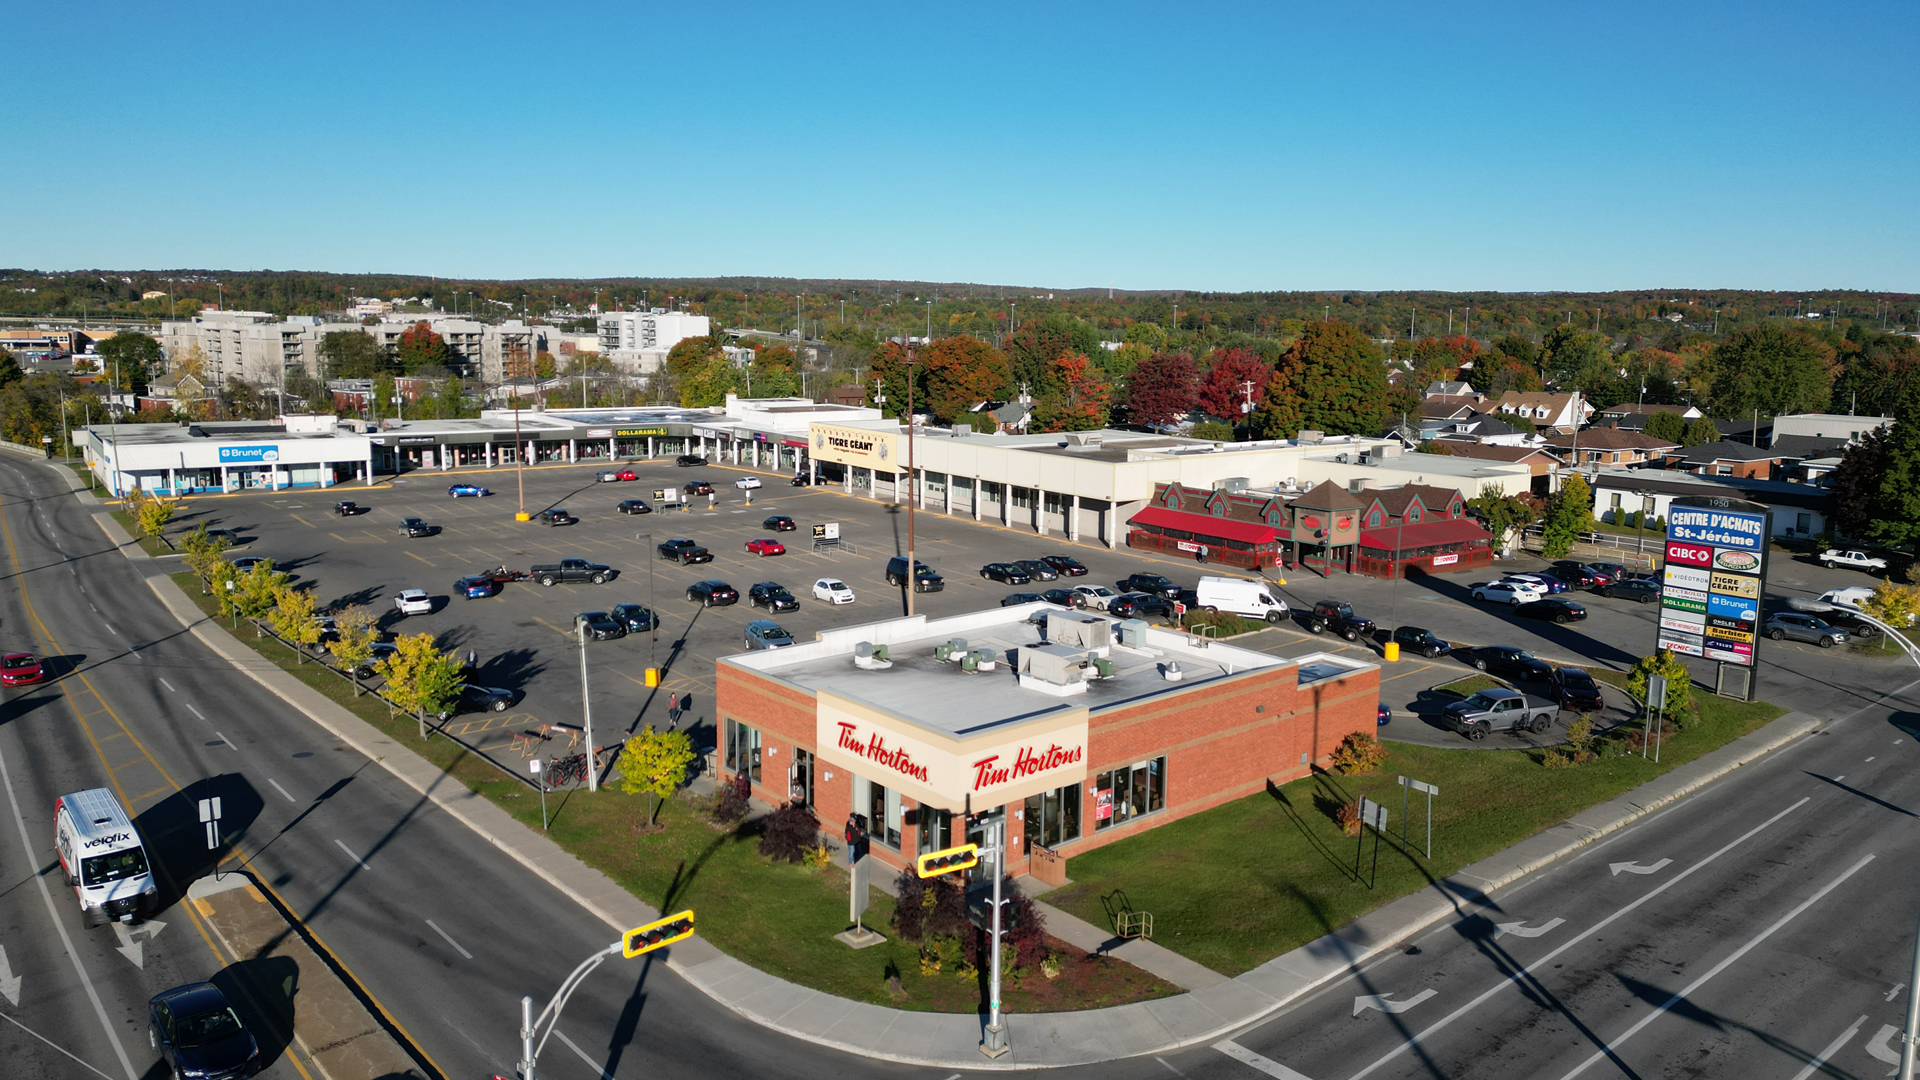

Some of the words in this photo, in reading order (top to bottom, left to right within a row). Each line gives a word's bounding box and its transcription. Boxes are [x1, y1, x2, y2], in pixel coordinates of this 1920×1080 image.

[828, 436, 848, 448] TIGRE
[231, 448, 263, 457] Brunet
[1709, 499, 1729, 508] 1950
[1671, 512, 1709, 527] CENTRE
[1710, 514, 1761, 535] D'ACHATS
[1674, 526, 1754, 546] St-Jérôme
[1669, 547, 1697, 560] CIBC
[1714, 576, 1739, 585] TIGRE
[1663, 599, 1706, 611] DOLLARAMA
[1720, 598, 1749, 609] Brunet
[1712, 627, 1747, 638] Barbier
[837, 721, 865, 757] Tim
[867, 732, 928, 783] Hortons
[973, 755, 1010, 791] Tim
[1012, 743, 1082, 780] Hortons
[84, 832, 131, 849] velofix
